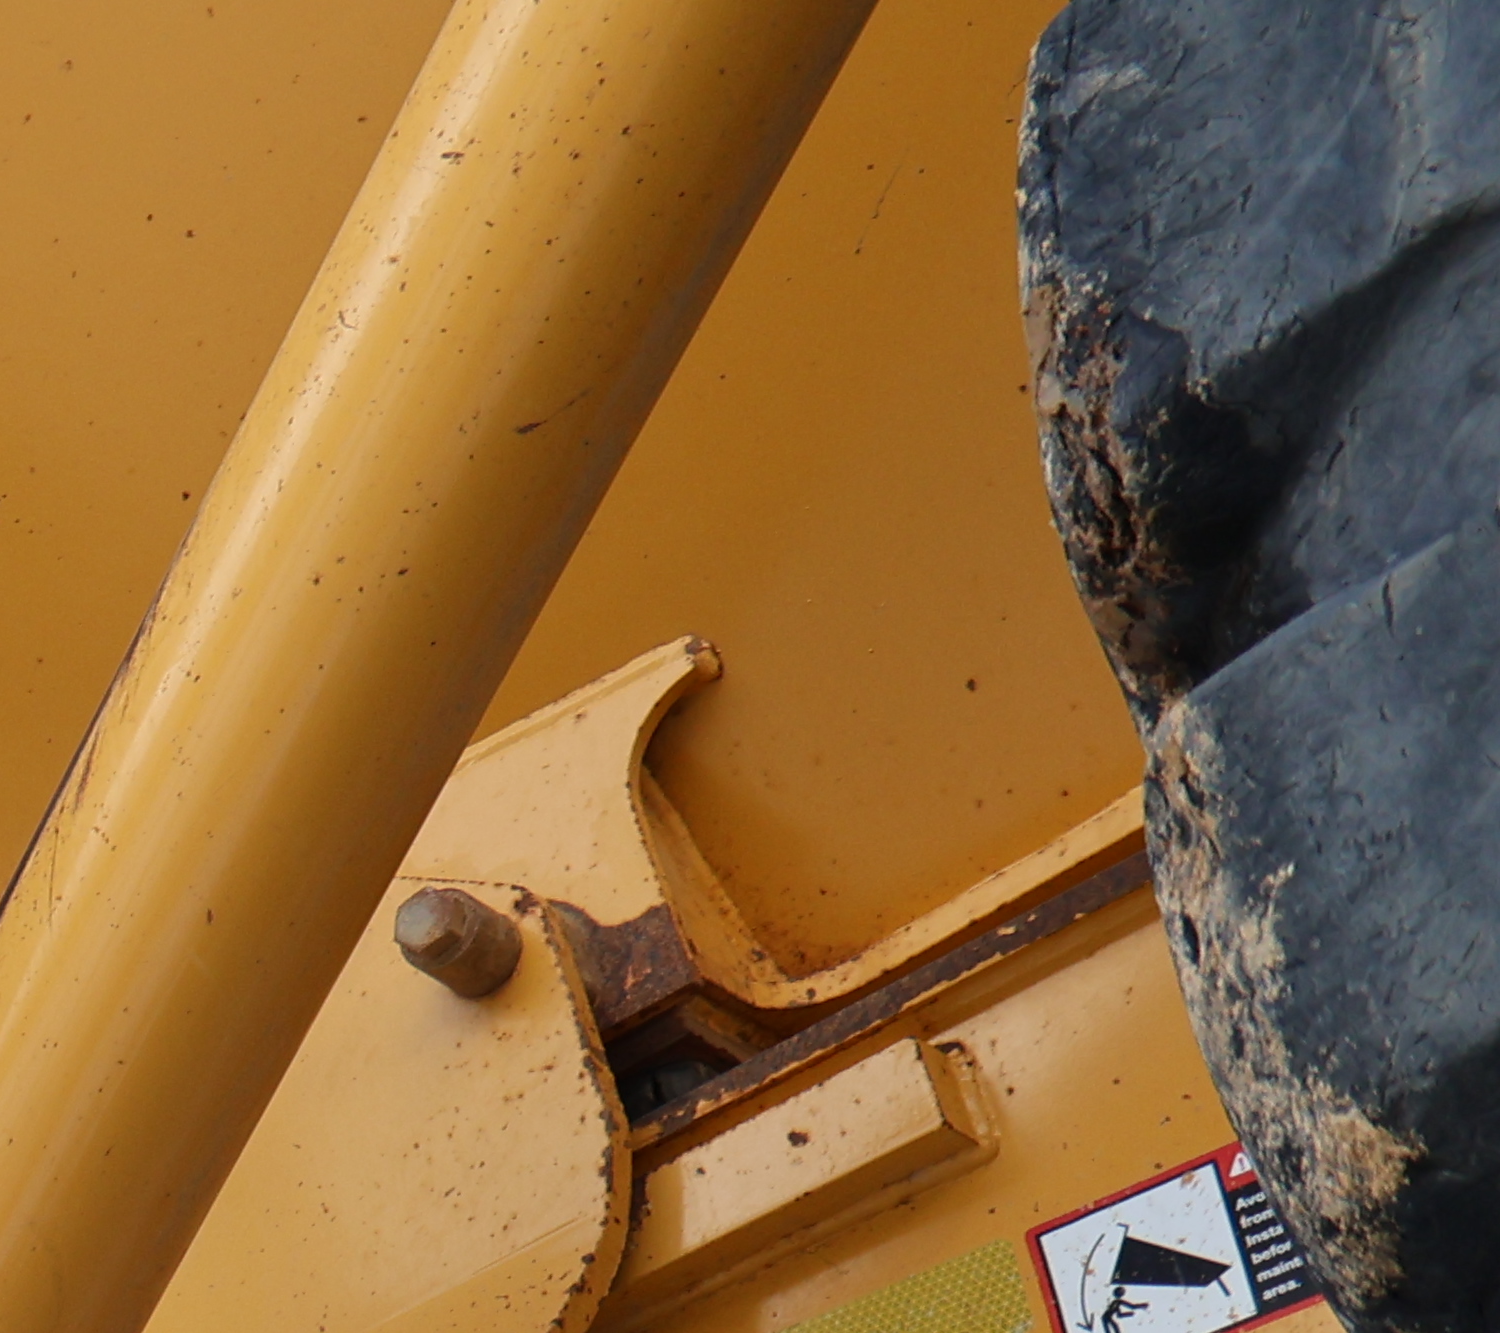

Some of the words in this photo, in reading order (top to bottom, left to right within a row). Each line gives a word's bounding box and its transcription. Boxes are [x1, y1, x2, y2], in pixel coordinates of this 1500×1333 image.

[1235, 1192, 1266, 1212] Avo
[1245, 1224, 1285, 1248] Insta
[1251, 1240, 1293, 1265] befor
[1256, 1255, 1305, 1283] maint
